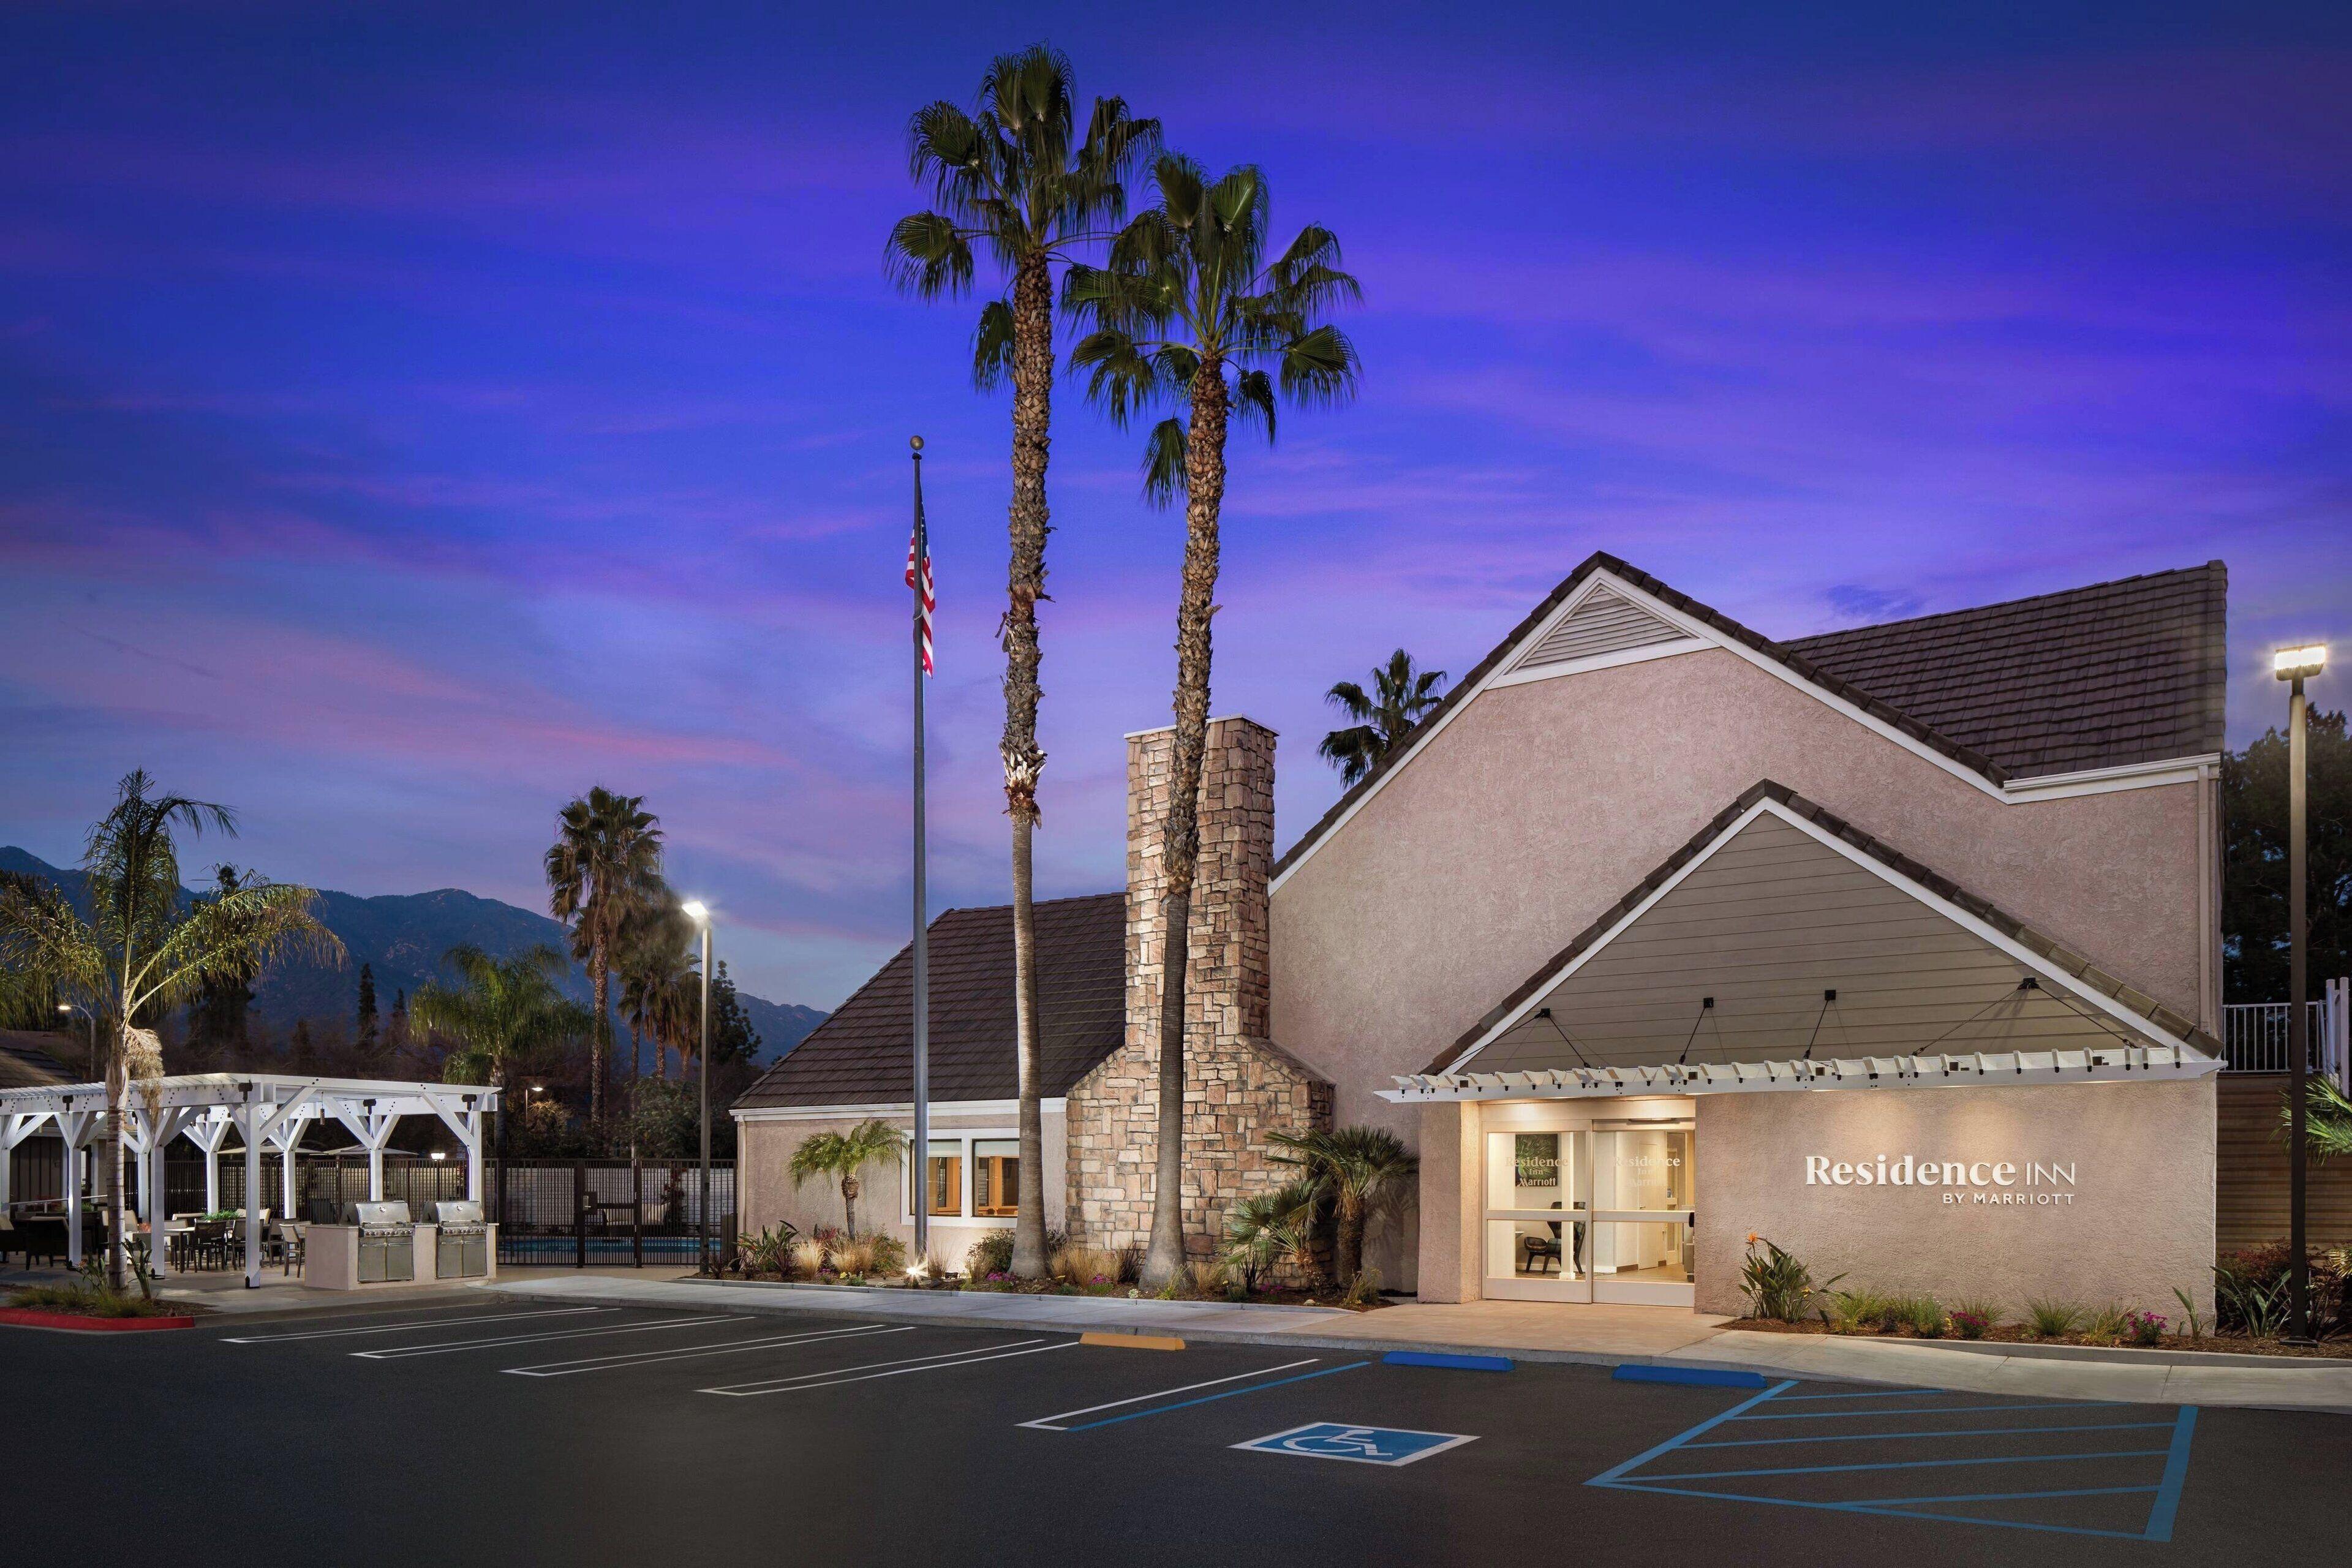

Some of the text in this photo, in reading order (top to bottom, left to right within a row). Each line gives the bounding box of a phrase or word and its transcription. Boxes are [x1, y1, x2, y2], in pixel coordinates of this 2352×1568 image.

[1505, 1156, 1569, 1167] Residence
[1806, 1154, 2075, 1186] Residence INN
[1517, 1177, 1556, 1187] Marriott
[1943, 1193, 2075, 1205] BY MARRIOTT
